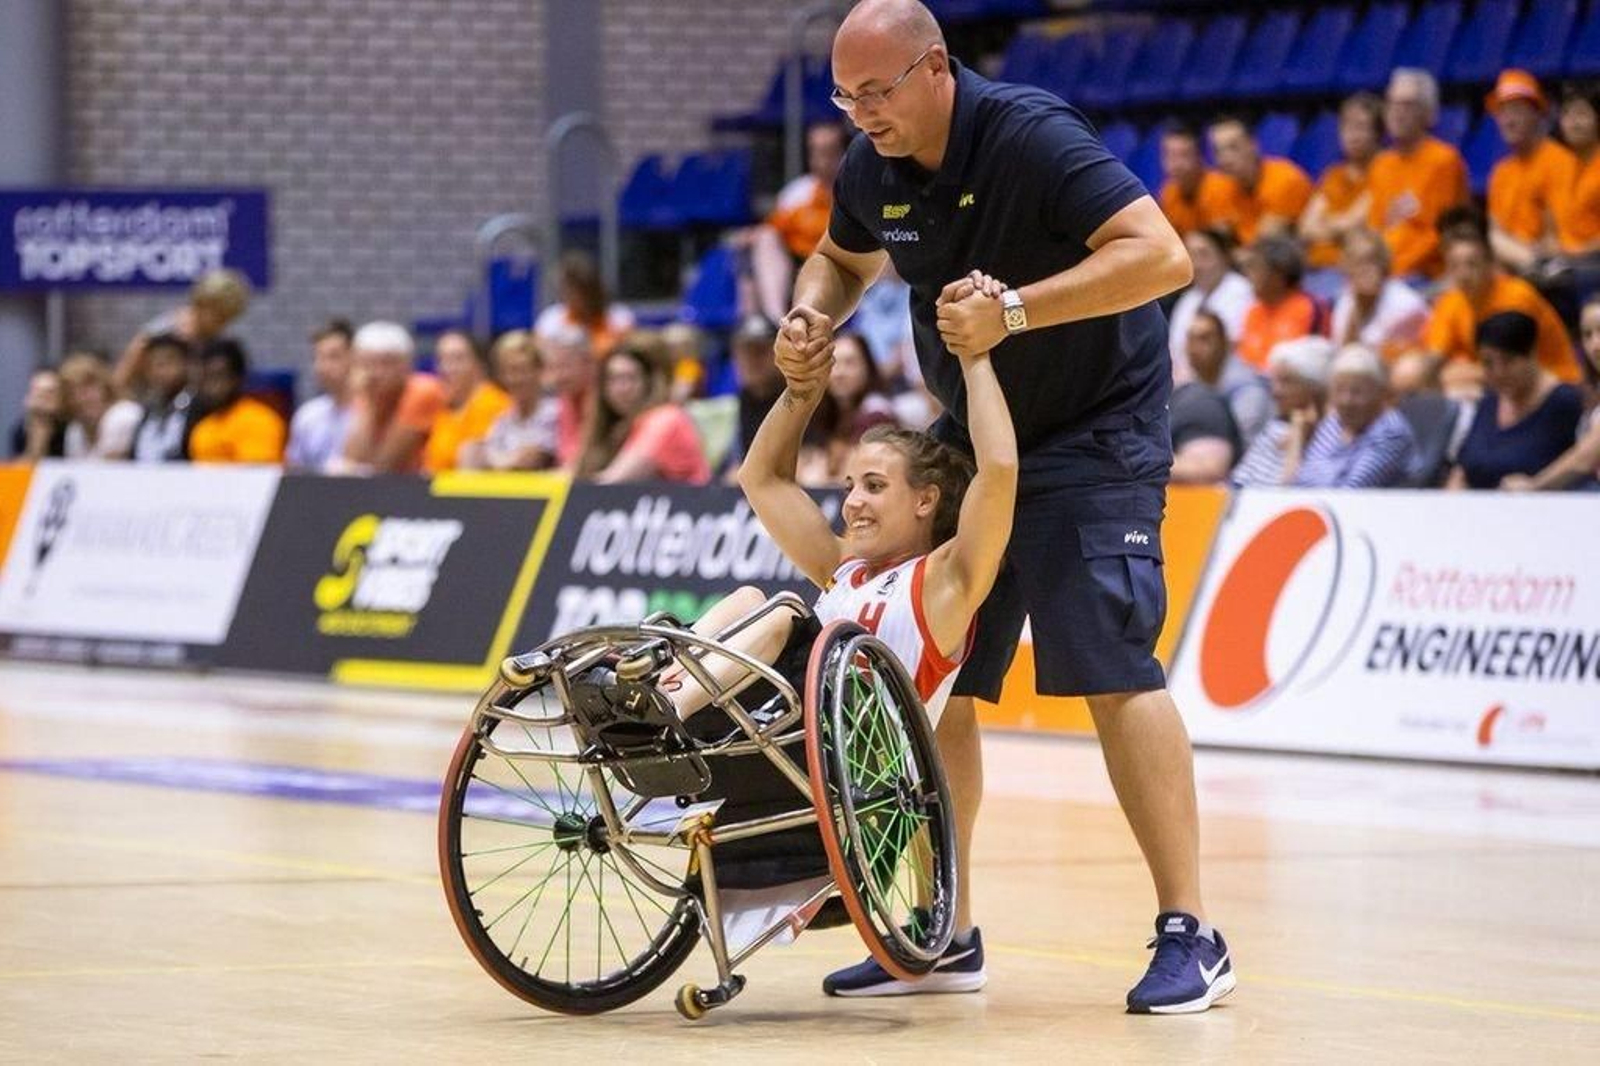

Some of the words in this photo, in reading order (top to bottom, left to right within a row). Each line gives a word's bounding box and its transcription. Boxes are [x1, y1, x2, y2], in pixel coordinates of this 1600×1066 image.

[18, 239, 228, 282] TOPSPORT
[1124, 530, 1149, 545] vive
[1391, 560, 1577, 614] Rotterdam
